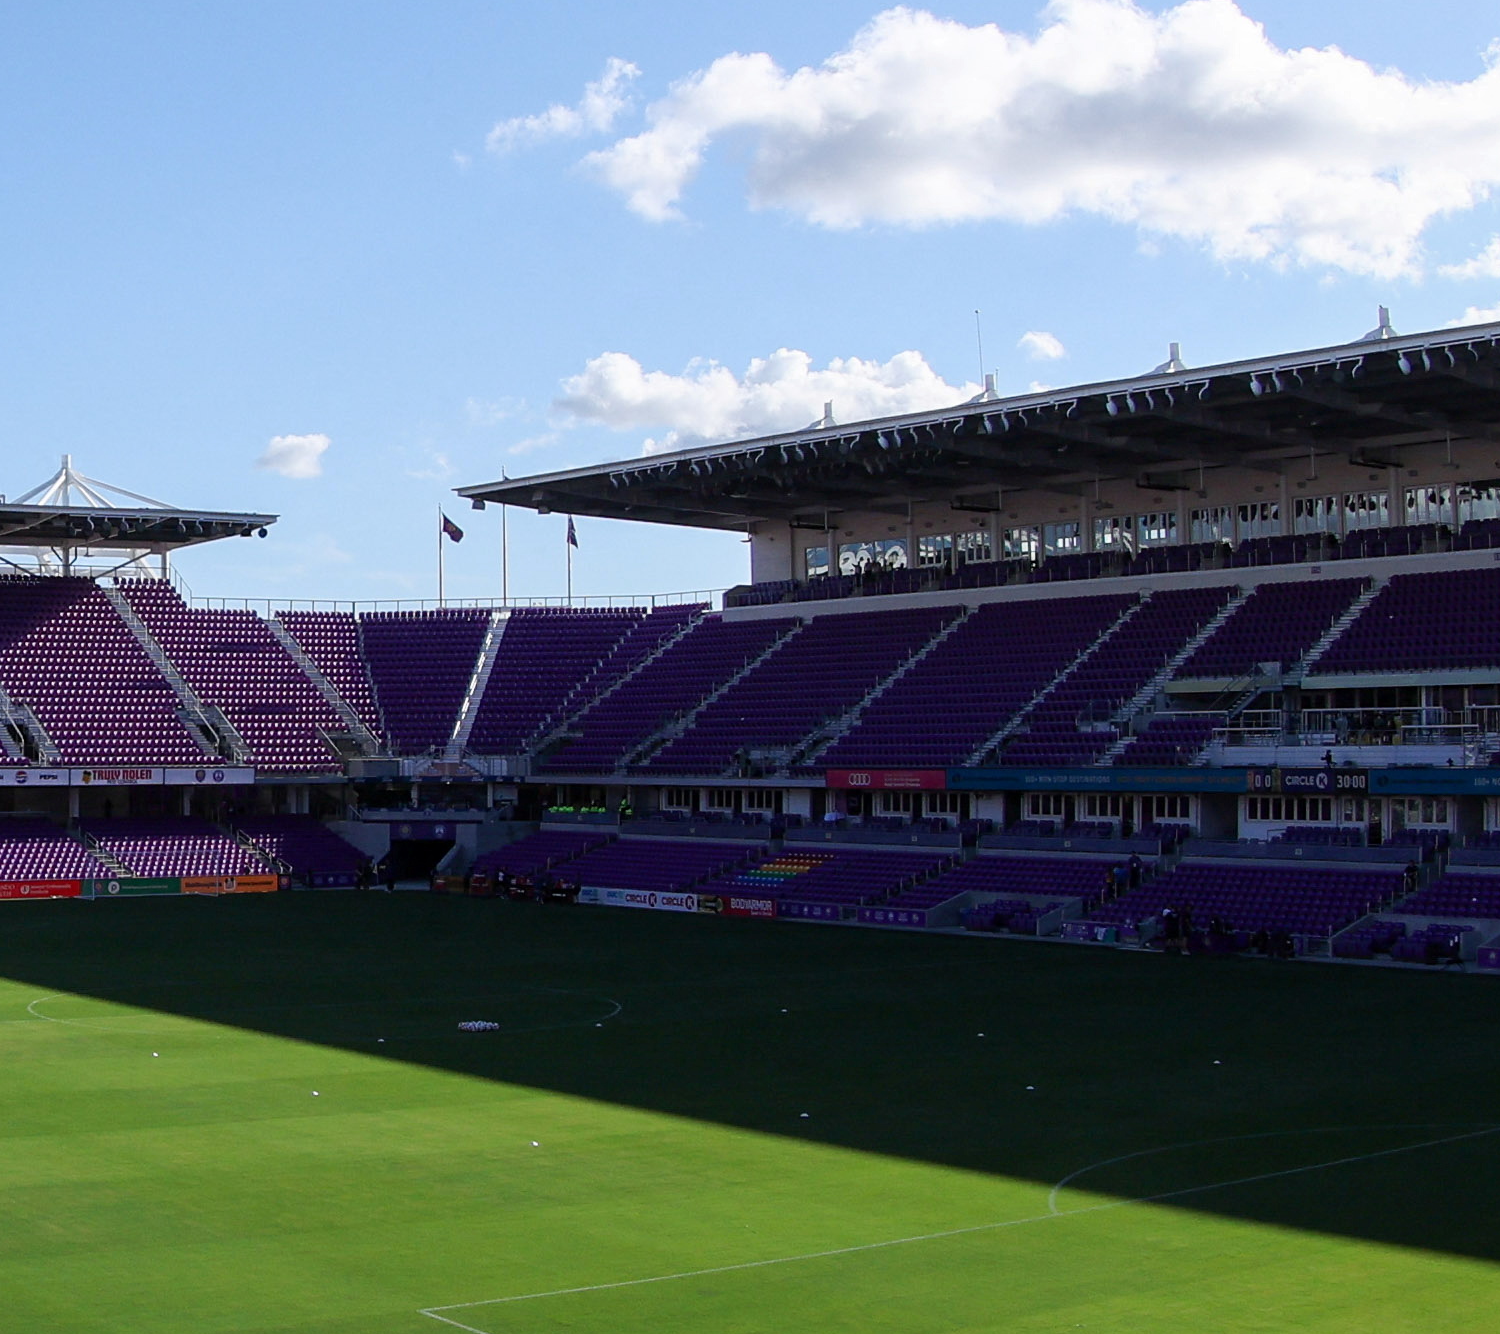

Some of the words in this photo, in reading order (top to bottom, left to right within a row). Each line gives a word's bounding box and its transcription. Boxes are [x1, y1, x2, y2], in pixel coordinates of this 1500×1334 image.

[92, 769, 122, 781] TRULY
[1285, 775, 1315, 786] CIRCLE
[1336, 774, 1366, 789] 30:00
[625, 893, 648, 904] CIRCLE
[661, 896, 685, 907] CIRCLE
